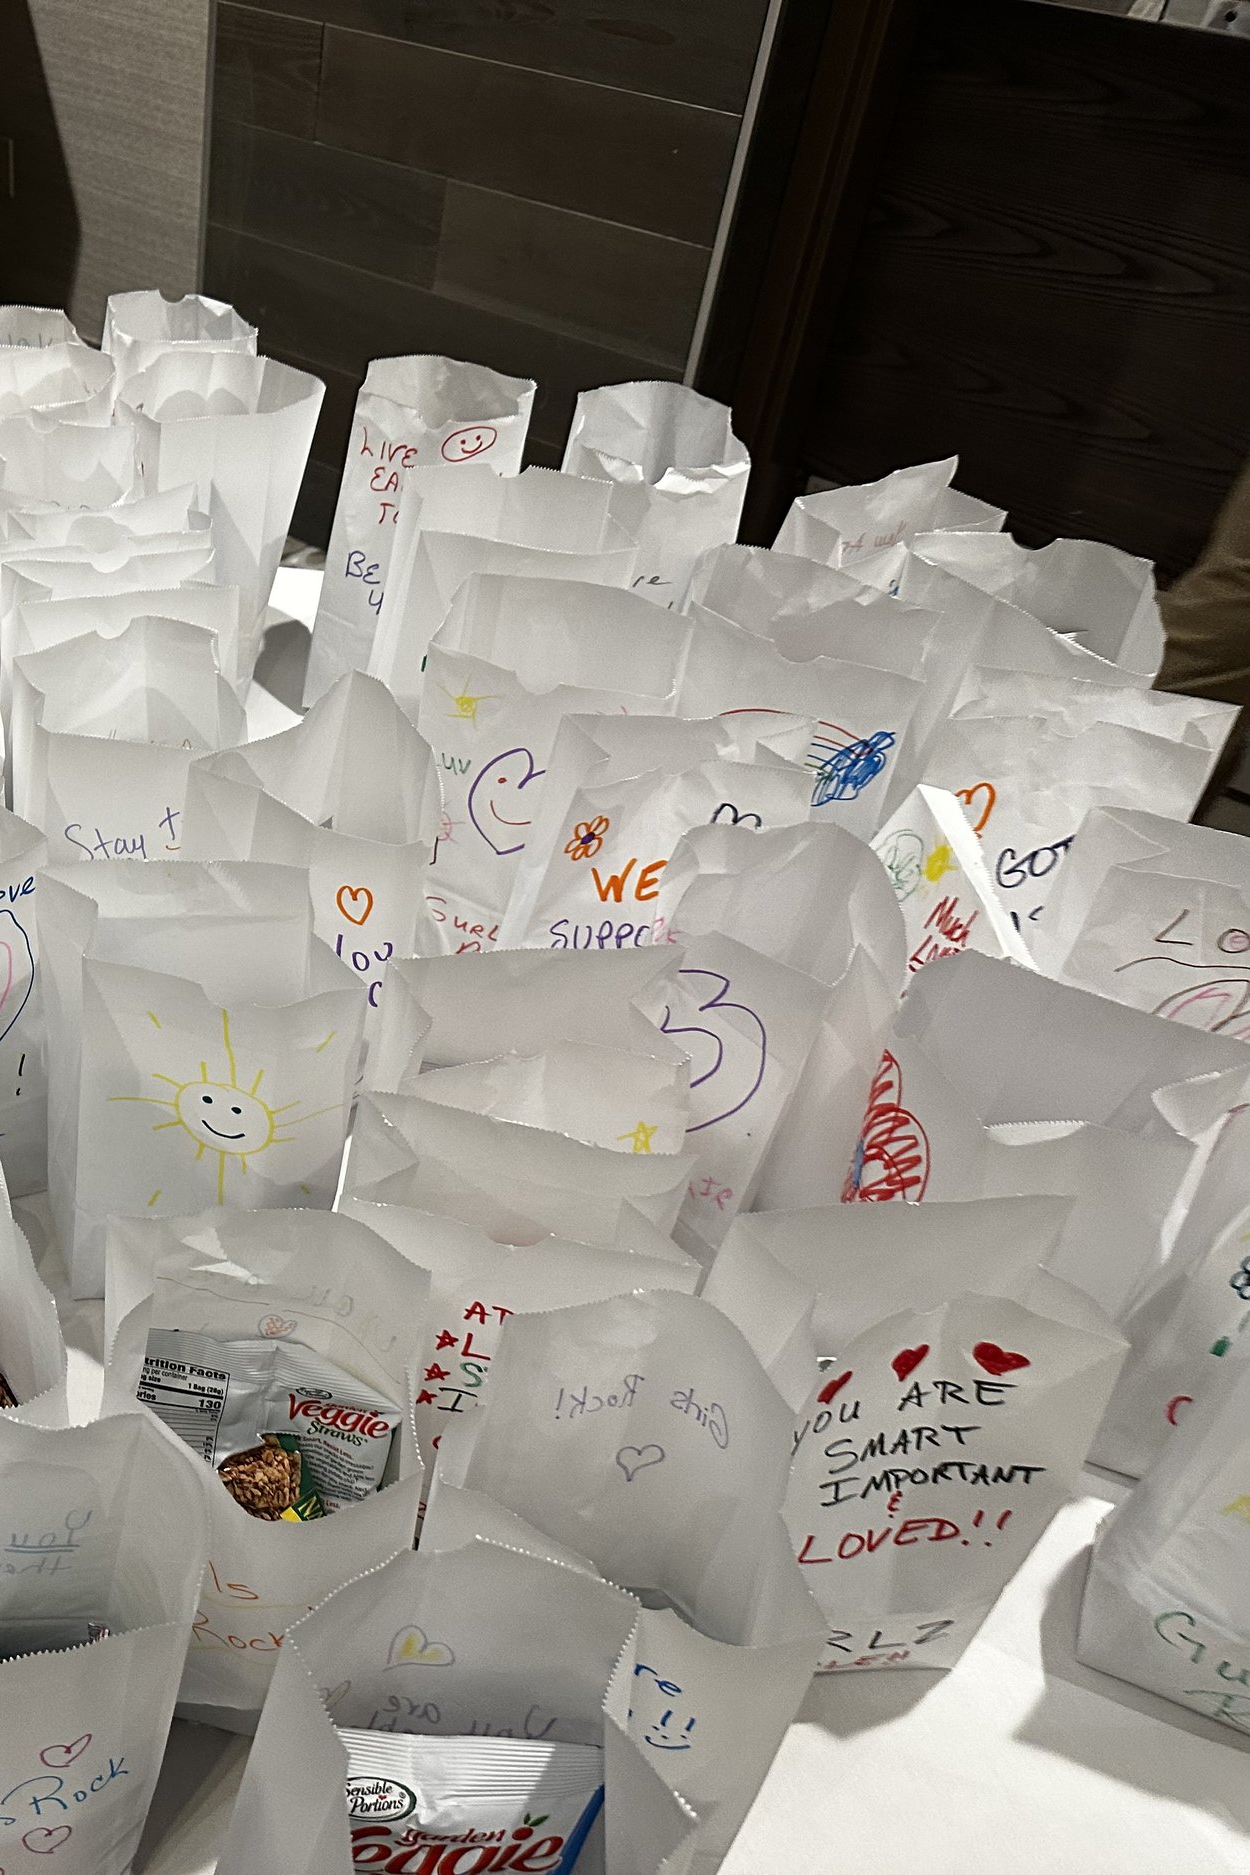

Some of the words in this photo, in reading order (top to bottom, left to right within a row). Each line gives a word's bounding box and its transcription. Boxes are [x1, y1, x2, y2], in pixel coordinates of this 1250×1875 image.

[370, 466, 399, 492] EA
[346, 550, 381, 584] BE
[64, 823, 147, 860] Stay
[591, 857, 669, 903] WE
[145, 1357, 186, 1373] trition
[190, 1366, 227, 1380] Facts
[198, 1398, 222, 1411] 130
[897, 1379, 1019, 1412] ARE
[288, 1393, 391, 1439] Veggie
[306, 1420, 363, 1447] Straws
[823, 1424, 982, 1475] SMART
[819, 1461, 1047, 1508] IMPORTANT
[797, 1508, 1013, 1565] LOVED!!
[0, 1756, 130, 1816] Rock
[350, 1797, 404, 1814] Portions
[394, 1828, 507, 1846] garden
